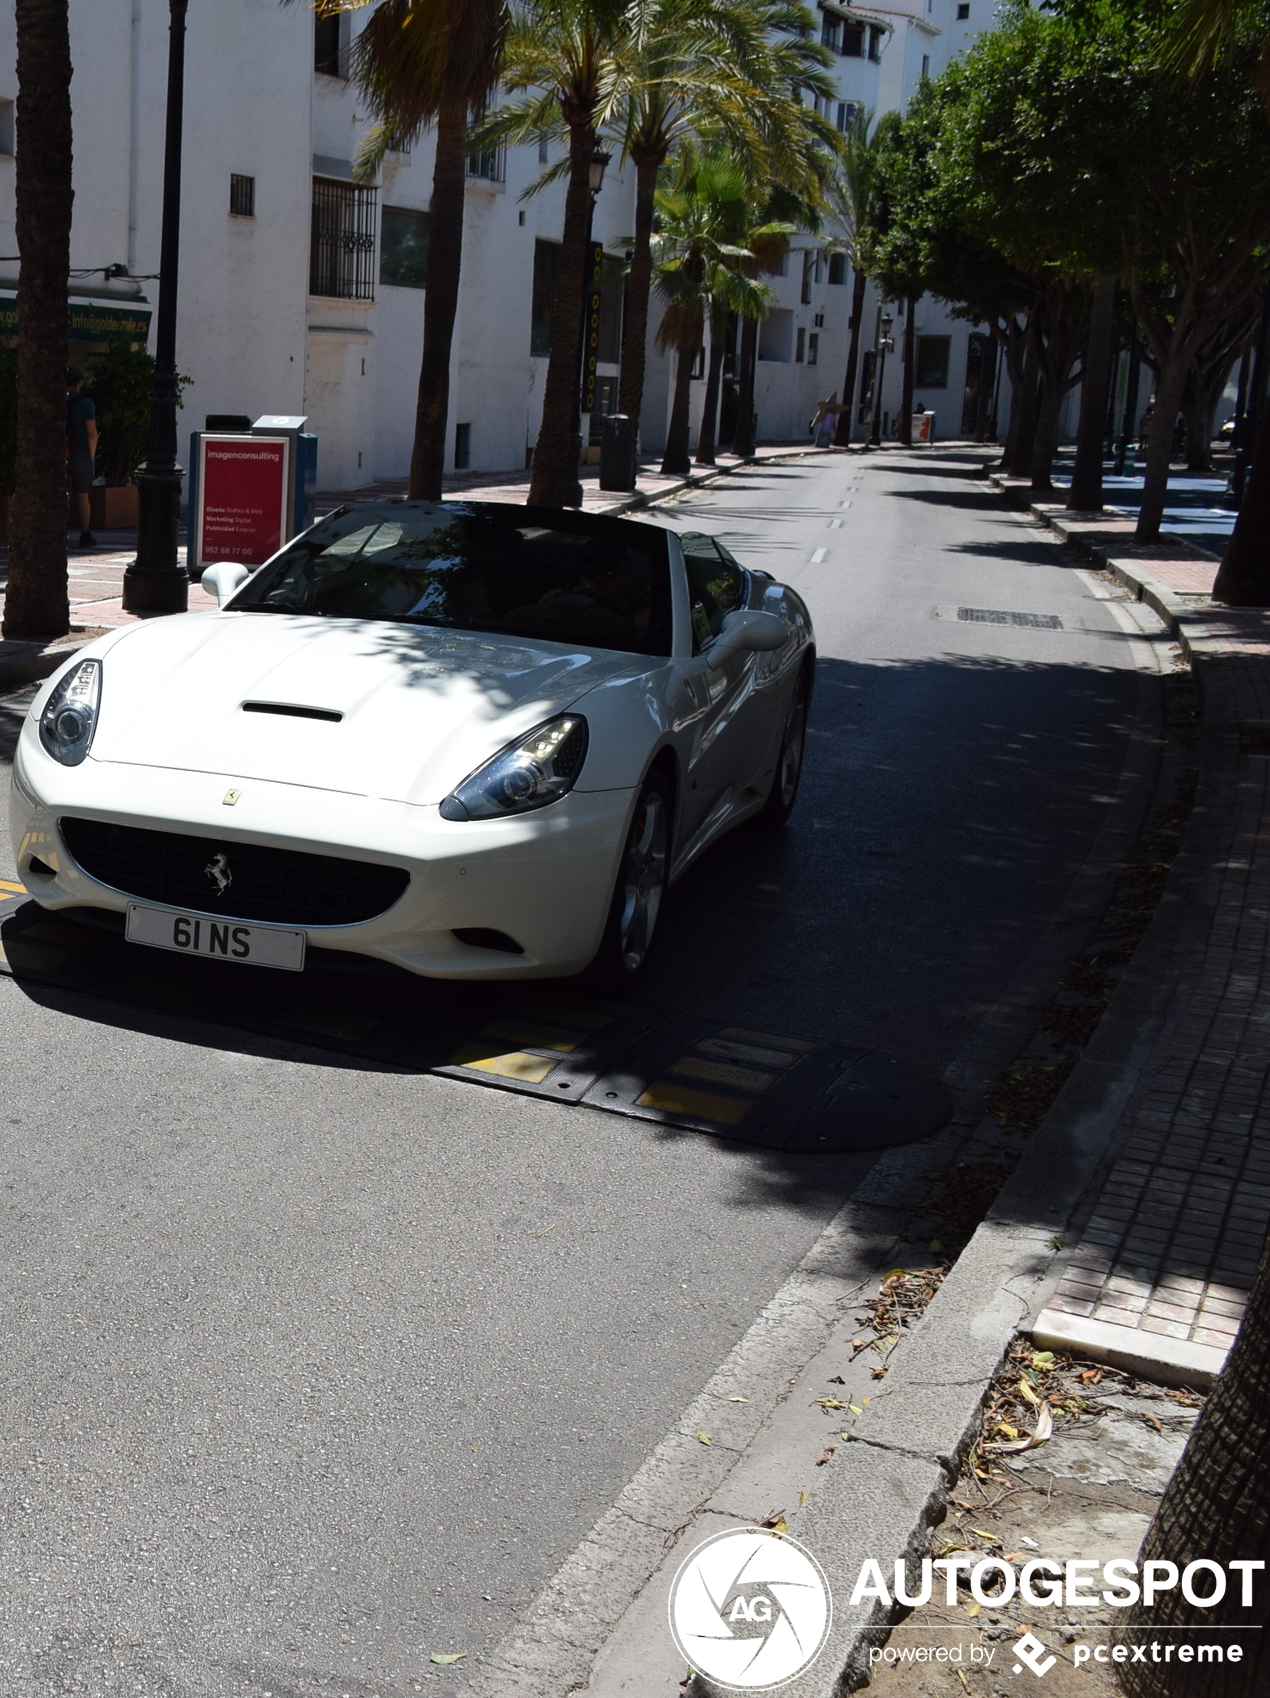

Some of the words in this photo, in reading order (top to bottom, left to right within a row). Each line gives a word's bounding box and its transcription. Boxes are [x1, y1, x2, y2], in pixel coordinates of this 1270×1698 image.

[207, 449, 279, 462] imagenconsulting
[206, 516, 234, 524] Marketing
[234, 517, 252, 525] Digital
[205, 546, 219, 554] 952
[232, 547, 240, 555] 77
[209, 922, 250, 958] NS
